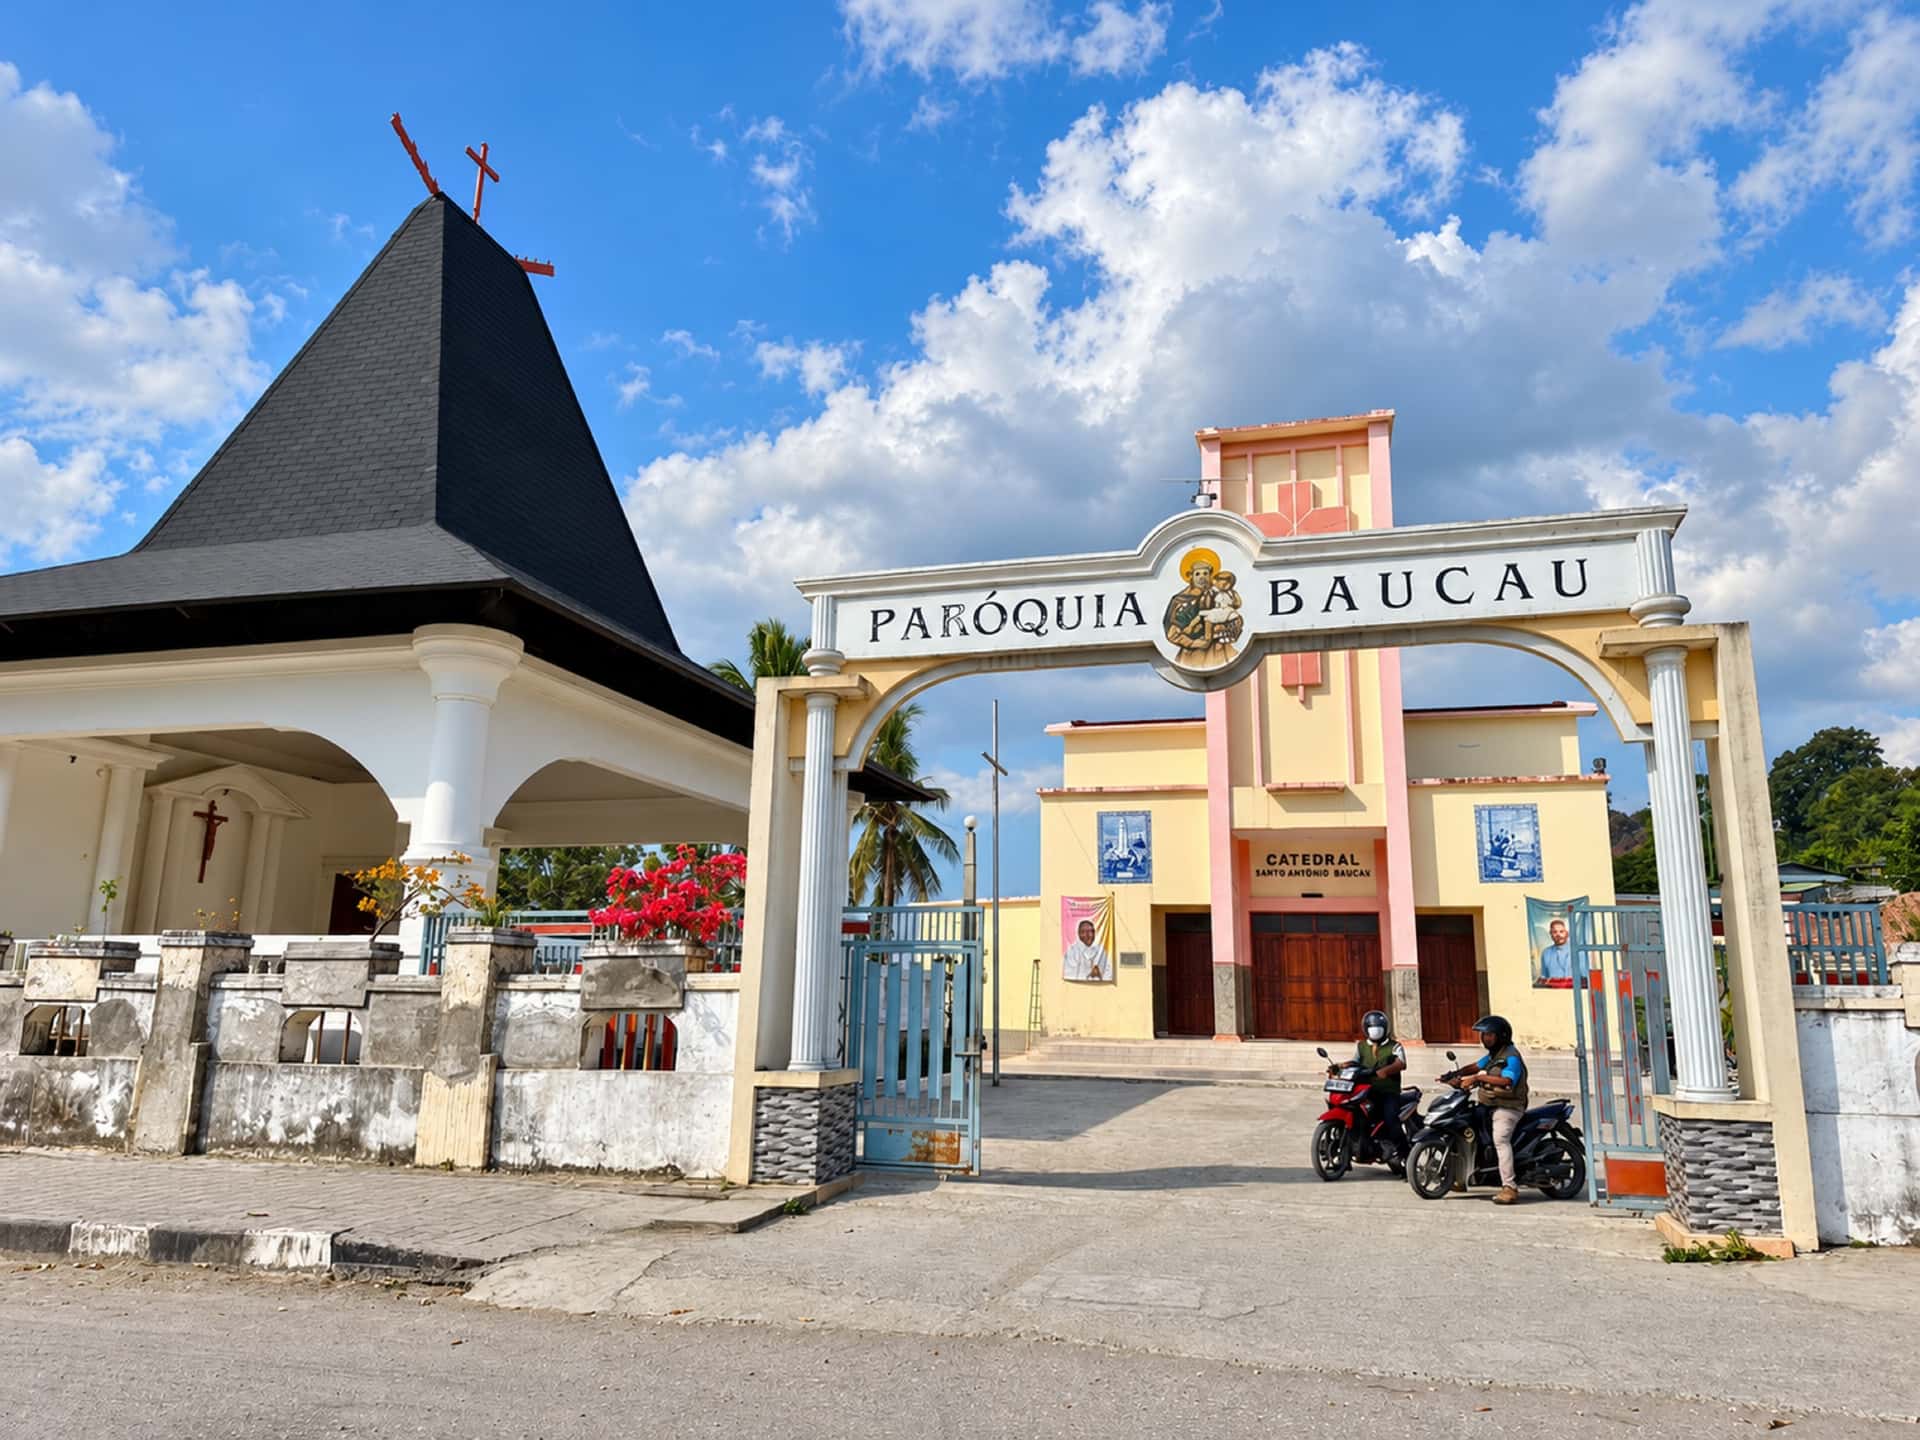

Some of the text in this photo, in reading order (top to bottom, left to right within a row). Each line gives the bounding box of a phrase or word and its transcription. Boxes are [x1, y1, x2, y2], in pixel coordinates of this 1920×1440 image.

[869, 558, 1589, 643] PARÓQUIA BAUCAU
[1266, 853, 1360, 866] CATEDRAL
[1255, 869, 1285, 878] SANTO
